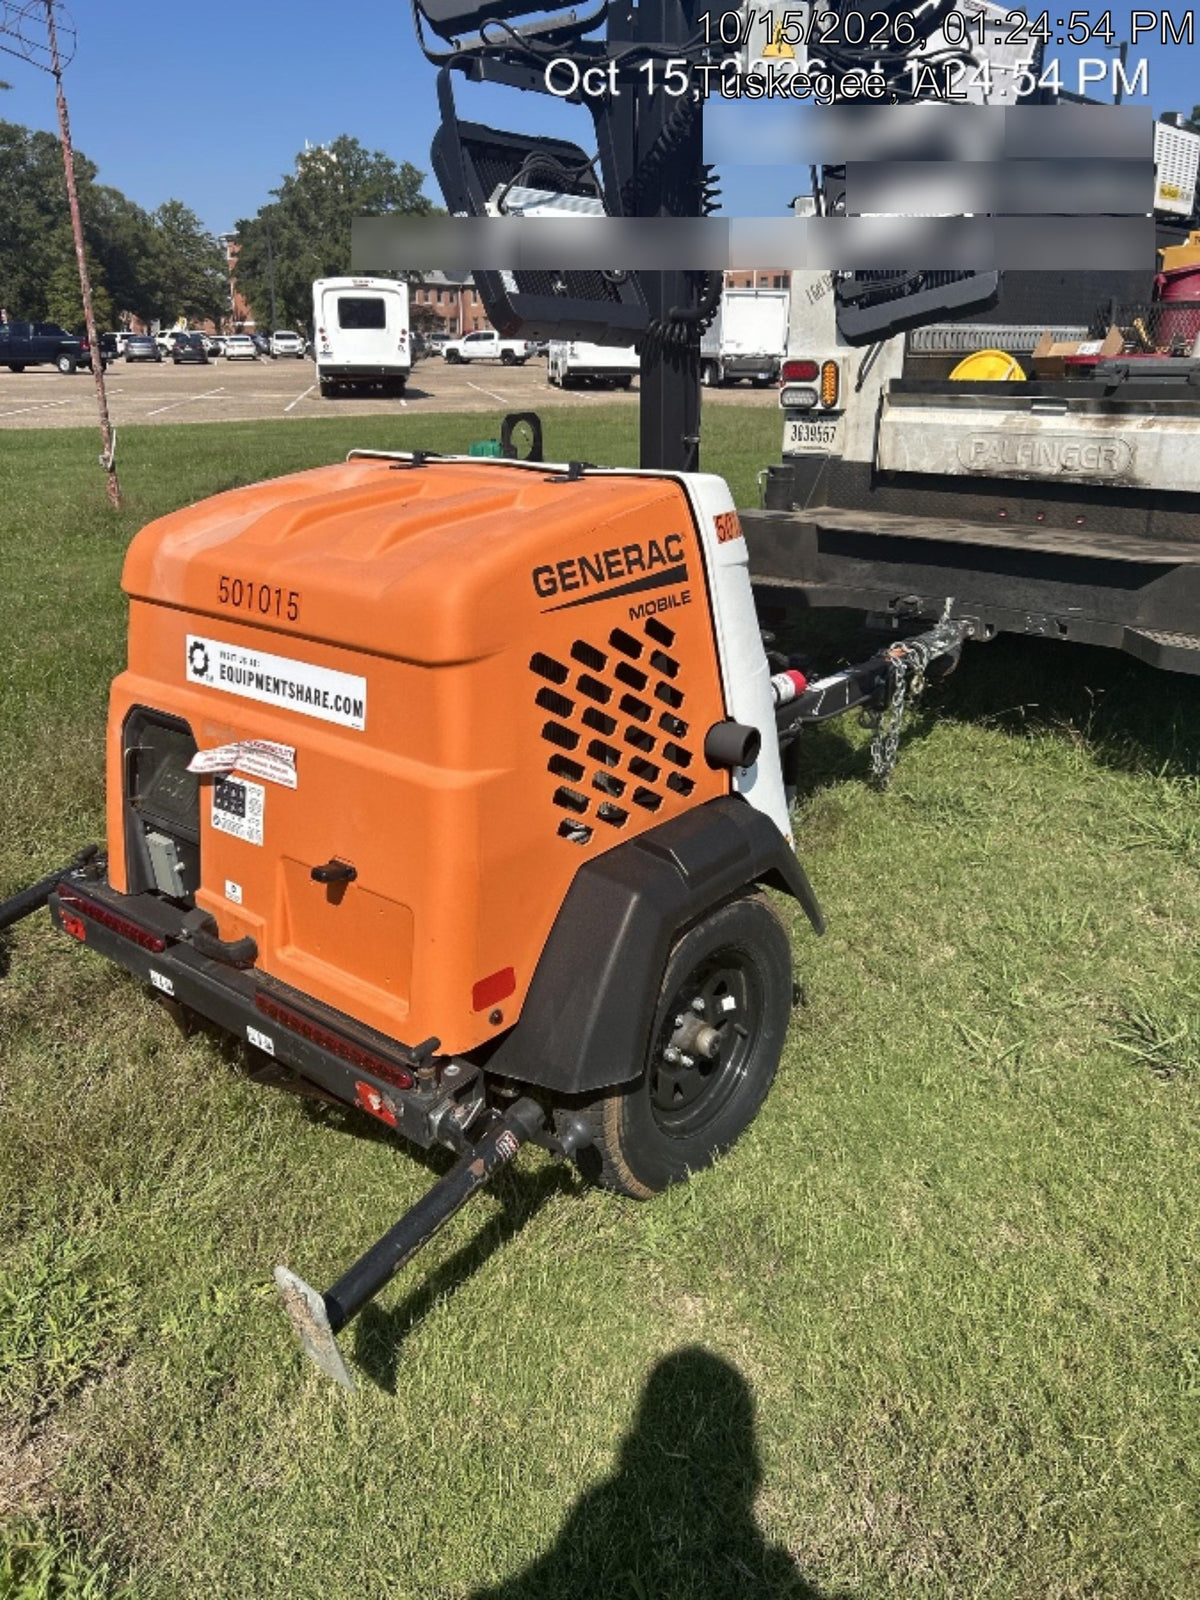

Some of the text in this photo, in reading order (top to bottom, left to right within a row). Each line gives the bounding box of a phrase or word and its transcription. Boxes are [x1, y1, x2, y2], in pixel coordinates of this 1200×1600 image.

[969, 438, 1120, 473] PALFINGER
[532, 534, 685, 598] GENERAC
[218, 576, 299, 621] 501015
[628, 590, 692, 621] MOBILE
[219, 664, 364, 719] EQUIPMENTSHARE.COM
